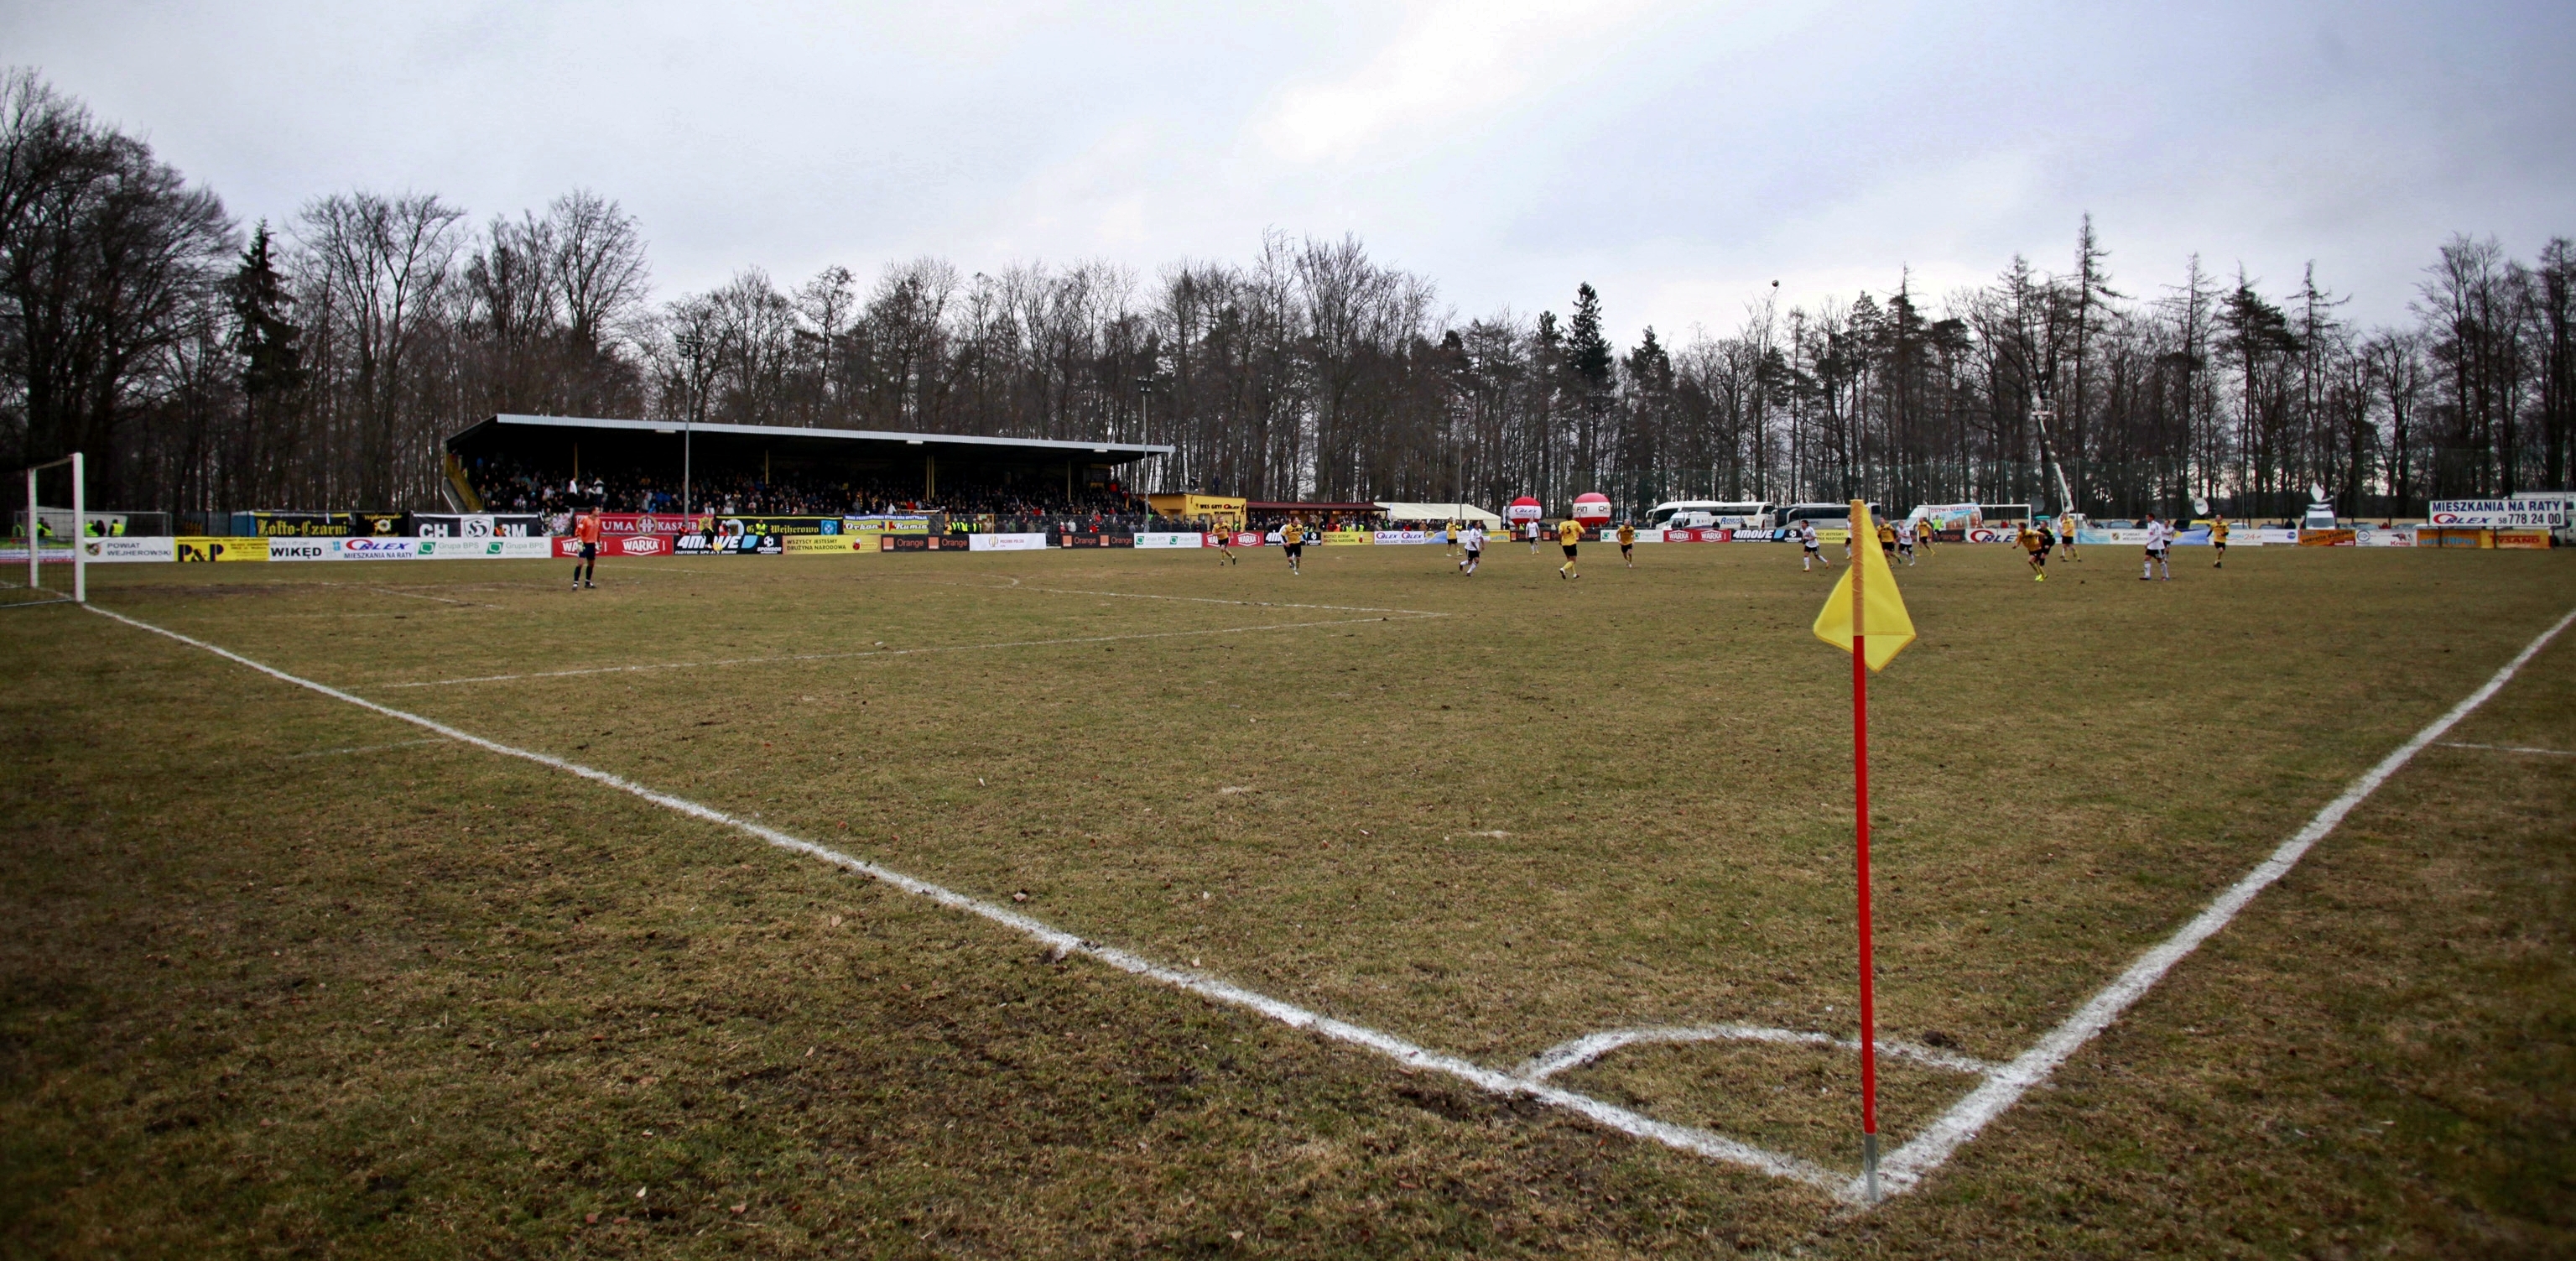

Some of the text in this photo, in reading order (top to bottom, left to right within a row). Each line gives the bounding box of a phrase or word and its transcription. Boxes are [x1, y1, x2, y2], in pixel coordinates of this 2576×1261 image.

[2432, 500, 2561, 513] MIESZKANIA NA RATY
[2433, 513, 2493, 524] ORLEX
[2508, 513, 2527, 524] 778
[2531, 513, 2544, 524] 24
[2547, 513, 2562, 524] 00
[1566, 525, 1571, 534] 5
[1733, 529, 1775, 539] 4MOVE
[1074, 537, 1097, 545] Orange
[1111, 537, 1132, 545] Orange
[1238, 534, 1257, 543] WARKA
[1970, 529, 2017, 543] ORLE
[622, 539, 658, 551] WARKA
[897, 539, 924, 549] Orange
[941, 538, 968, 548] Orange
[270, 547, 322, 560] WIKĘD
